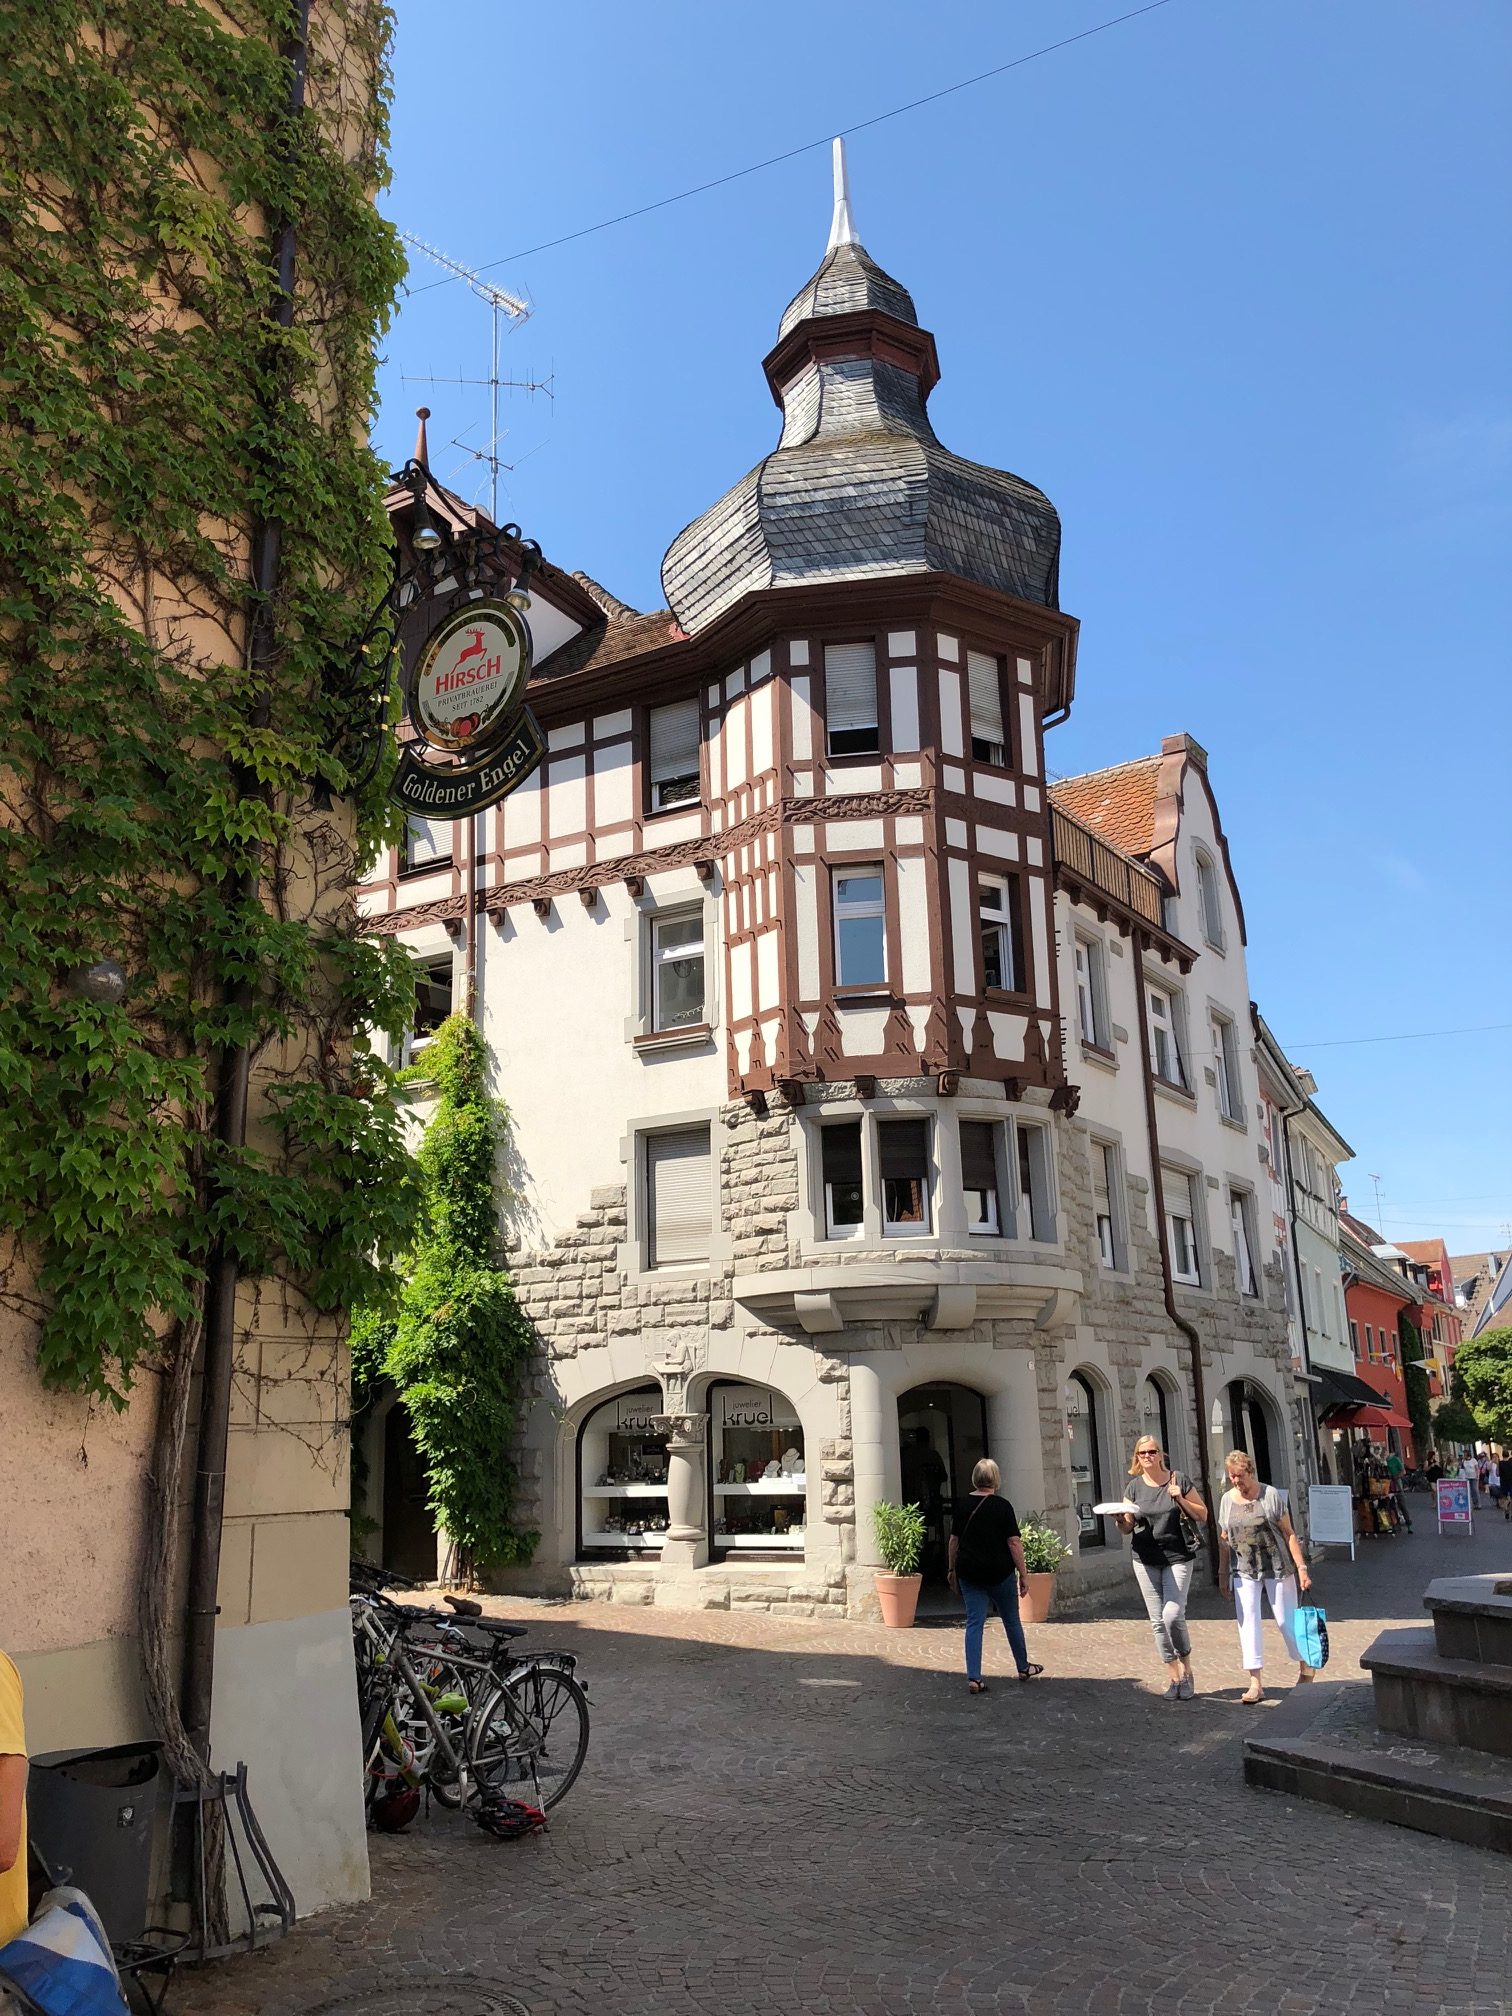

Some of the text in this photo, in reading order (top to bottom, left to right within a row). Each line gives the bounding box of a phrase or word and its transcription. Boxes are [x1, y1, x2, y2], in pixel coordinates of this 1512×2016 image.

[435, 655, 501, 695] HIRSCH
[437, 681, 498, 707] PRIVATBRAUEREI
[452, 696, 484, 711] SEIT 1782
[402, 739, 530, 804] Goldener Engel
[626, 1404, 654, 1415] juwelier
[722, 1394, 774, 1426] kruel
[732, 1399, 761, 1410] juwelier
